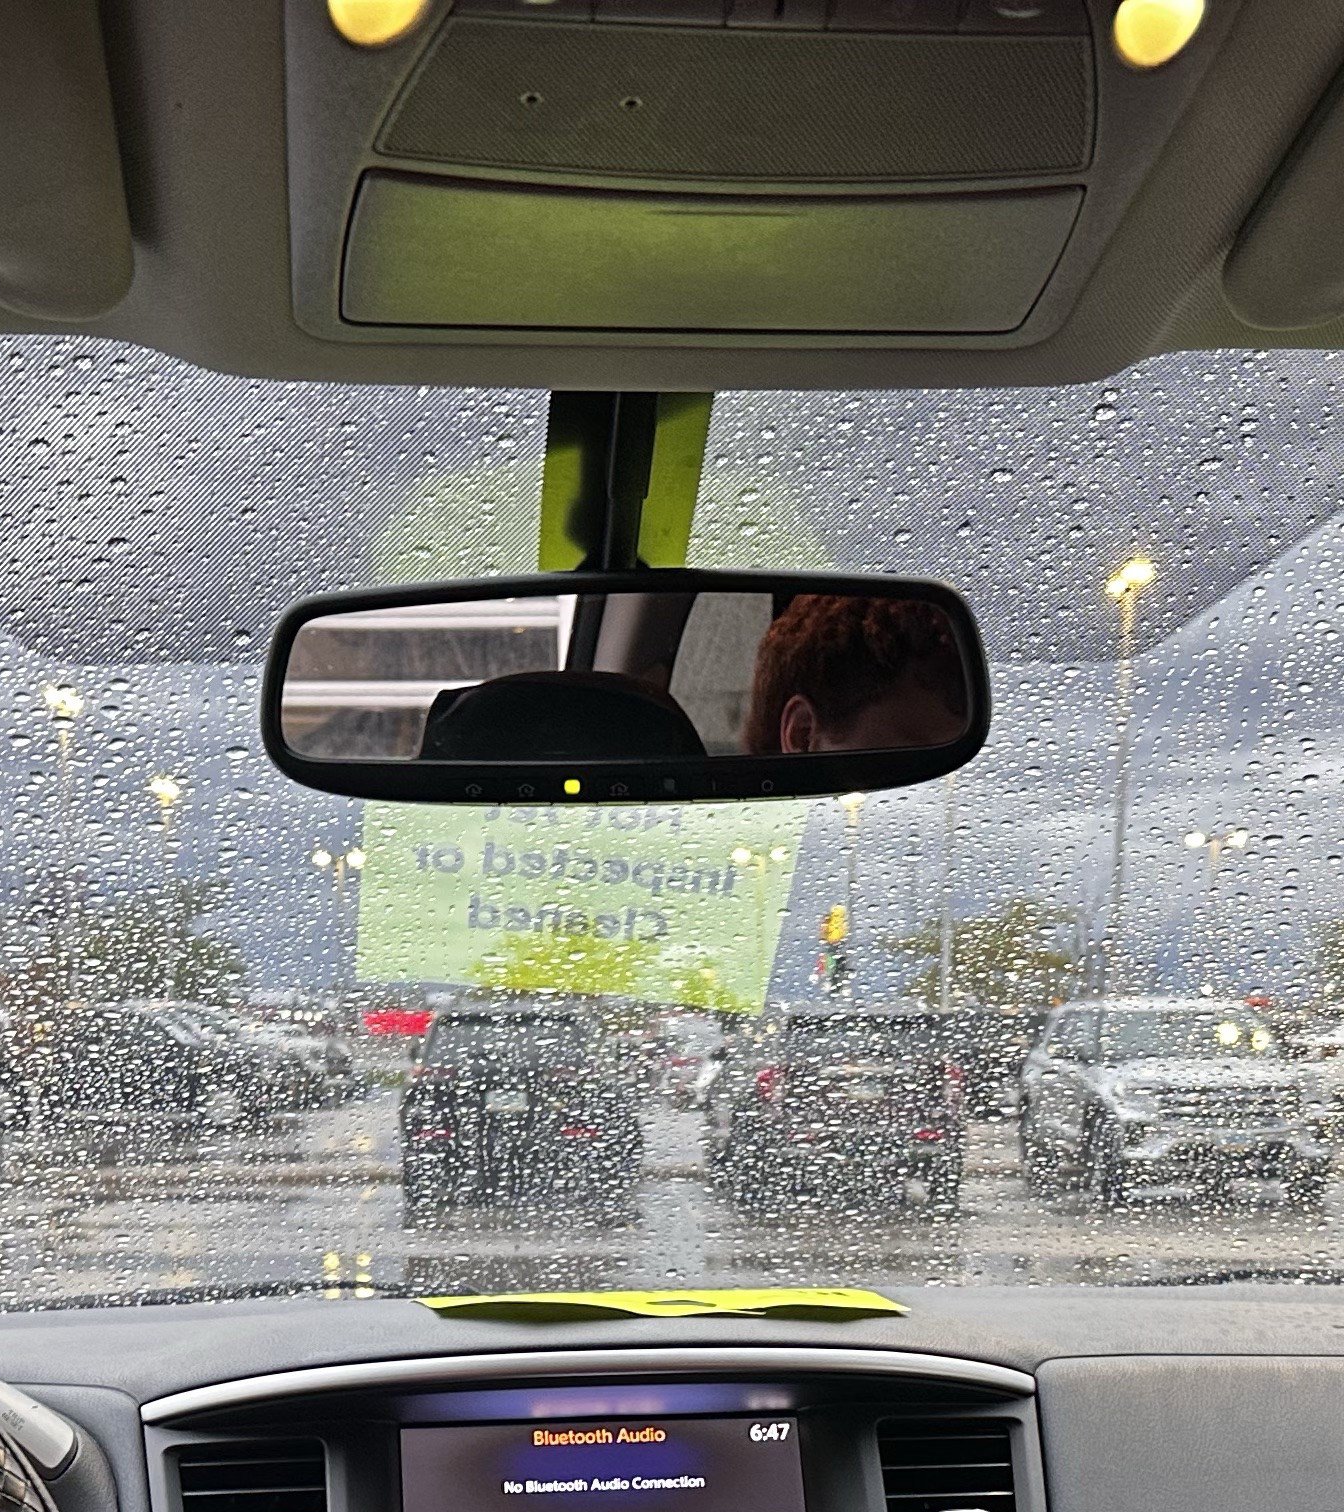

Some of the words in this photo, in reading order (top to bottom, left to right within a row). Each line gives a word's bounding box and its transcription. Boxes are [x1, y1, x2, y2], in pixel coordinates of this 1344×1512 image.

[532, 1428, 613, 1447] Bluetooth
[616, 1427, 666, 1444] Audio
[748, 1423, 790, 1442] 6:47
[503, 1480, 523, 1494] No
[525, 1479, 587, 1493] Bluetooth
[590, 1477, 629, 1491] Audio
[631, 1475, 705, 1490] Connection
